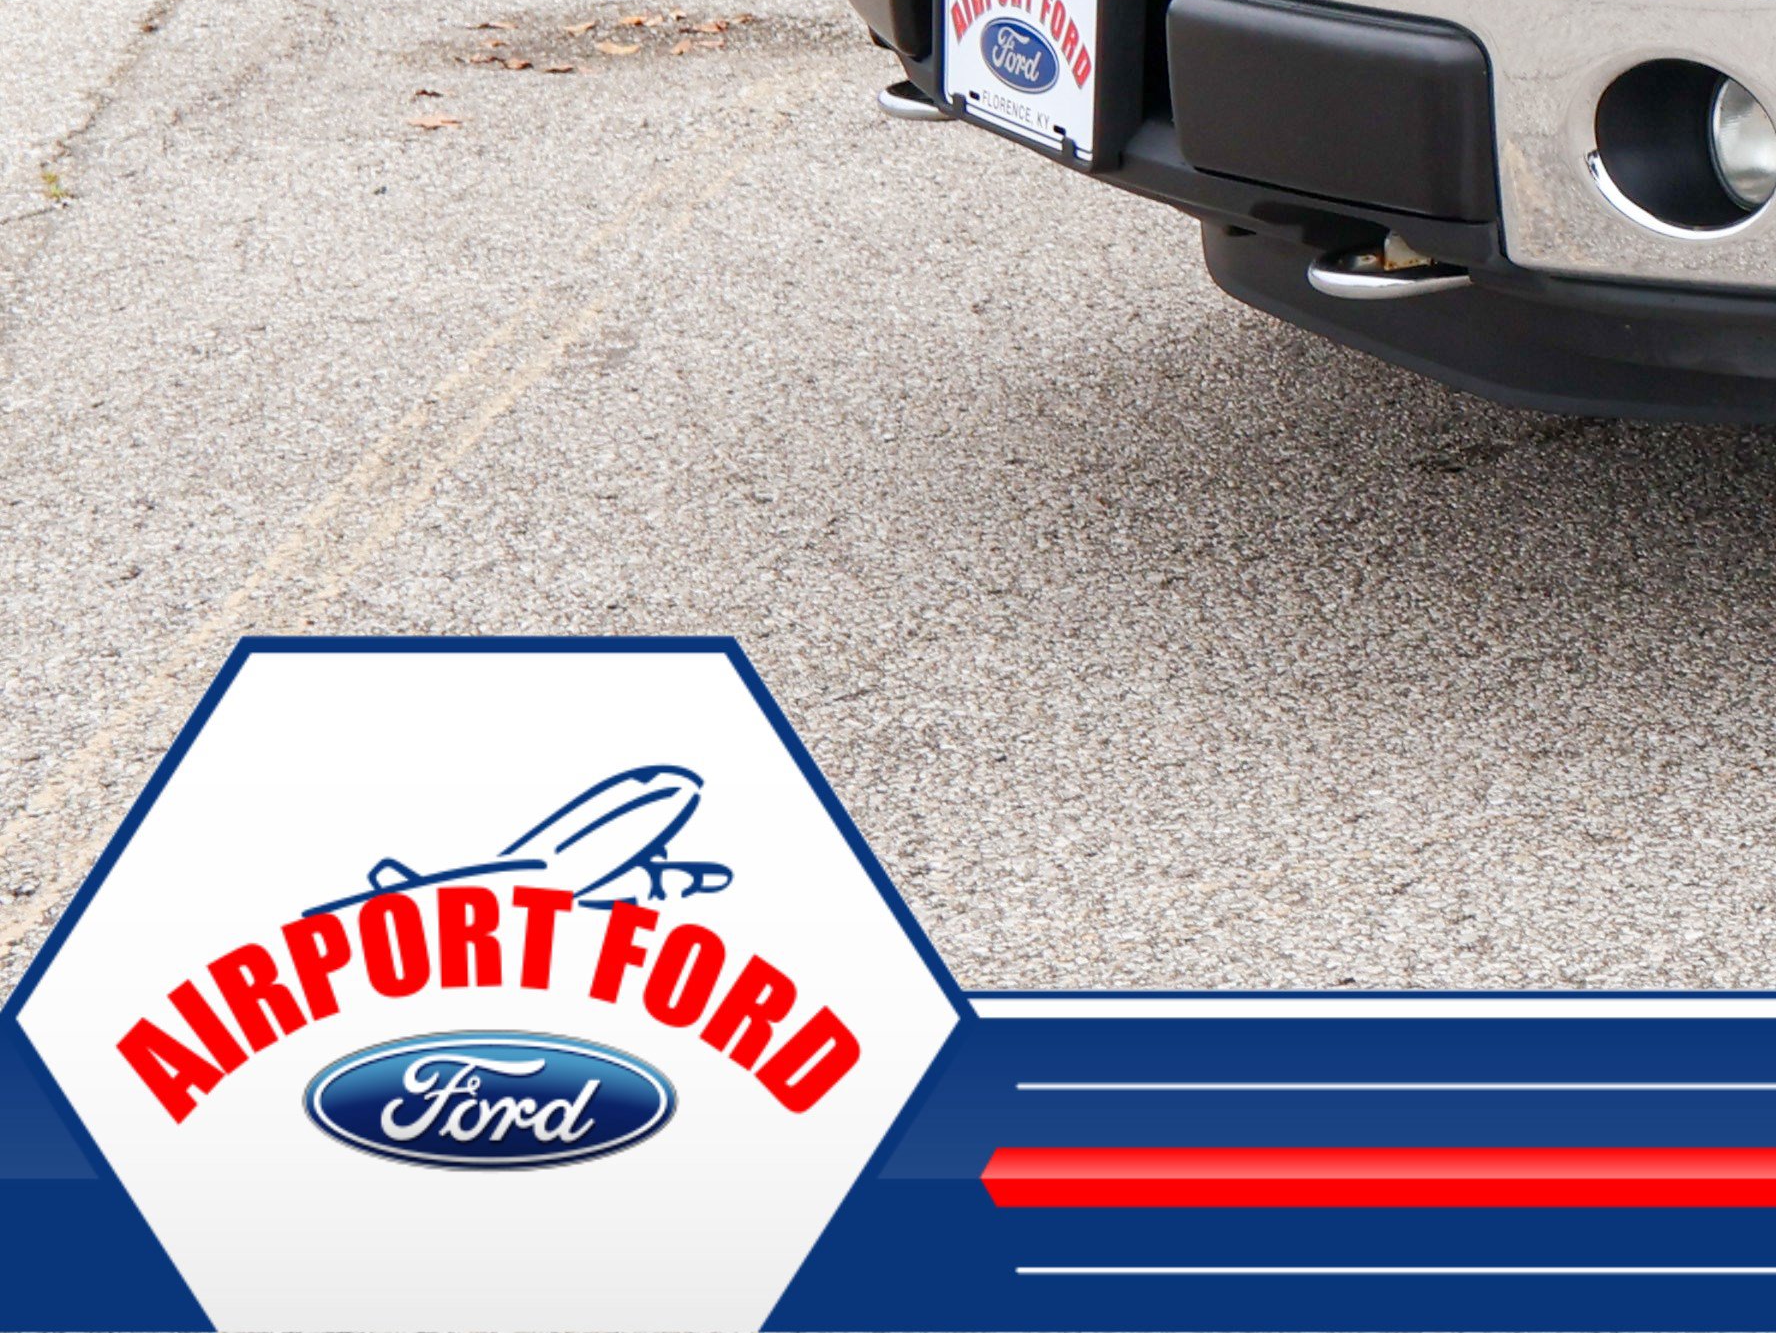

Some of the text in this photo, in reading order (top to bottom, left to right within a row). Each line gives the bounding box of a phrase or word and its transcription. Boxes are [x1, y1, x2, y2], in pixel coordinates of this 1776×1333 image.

[992, 26, 1041, 82] Ford
[982, 90, 1051, 129] FLORENCE, KY
